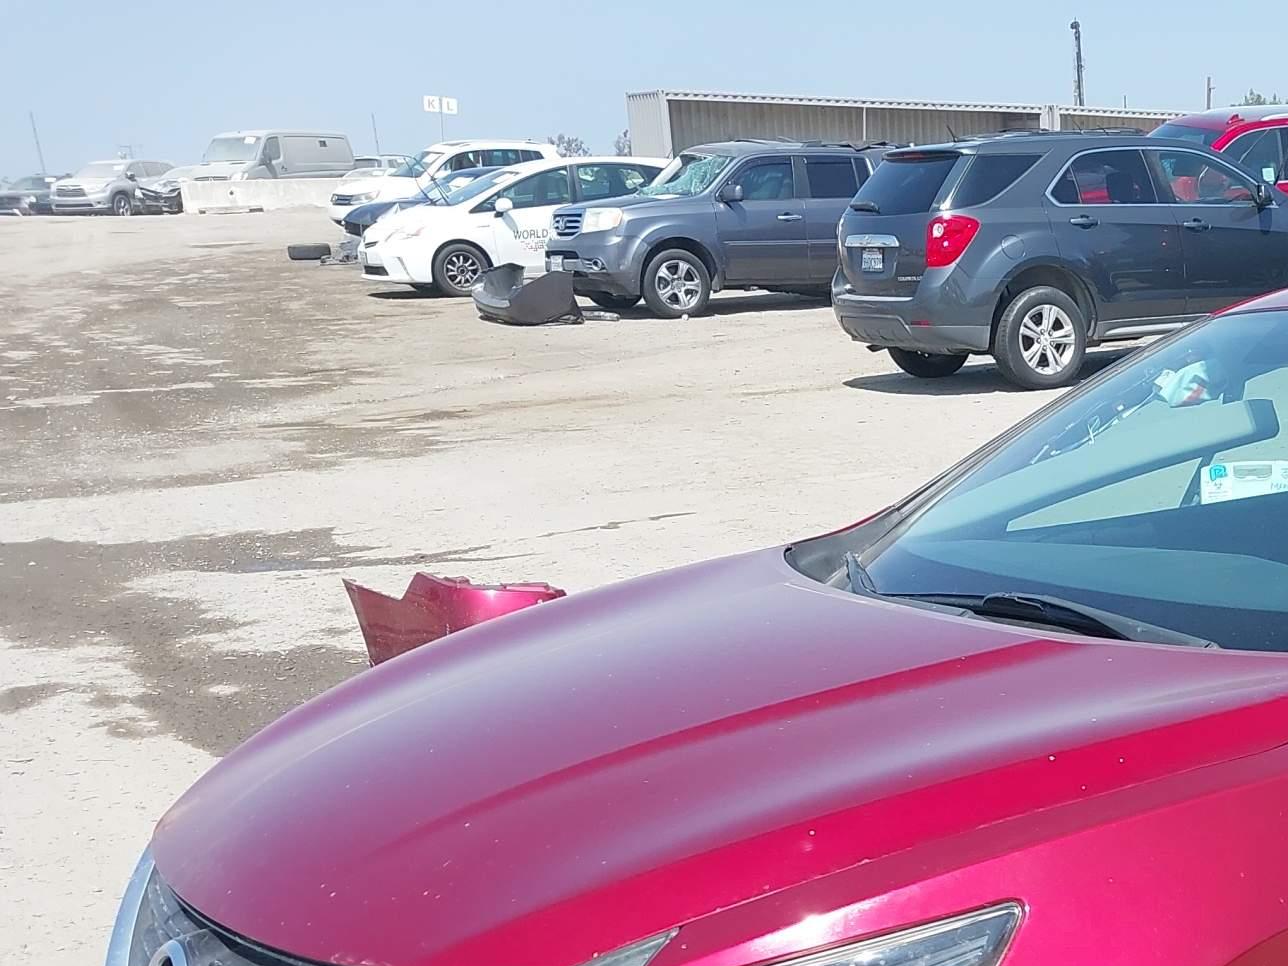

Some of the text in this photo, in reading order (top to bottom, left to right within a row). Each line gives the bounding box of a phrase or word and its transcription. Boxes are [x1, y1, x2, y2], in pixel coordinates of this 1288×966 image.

[427, 98, 437, 109] K
[446, 100, 455, 111] L
[513, 228, 549, 240] WORLD
